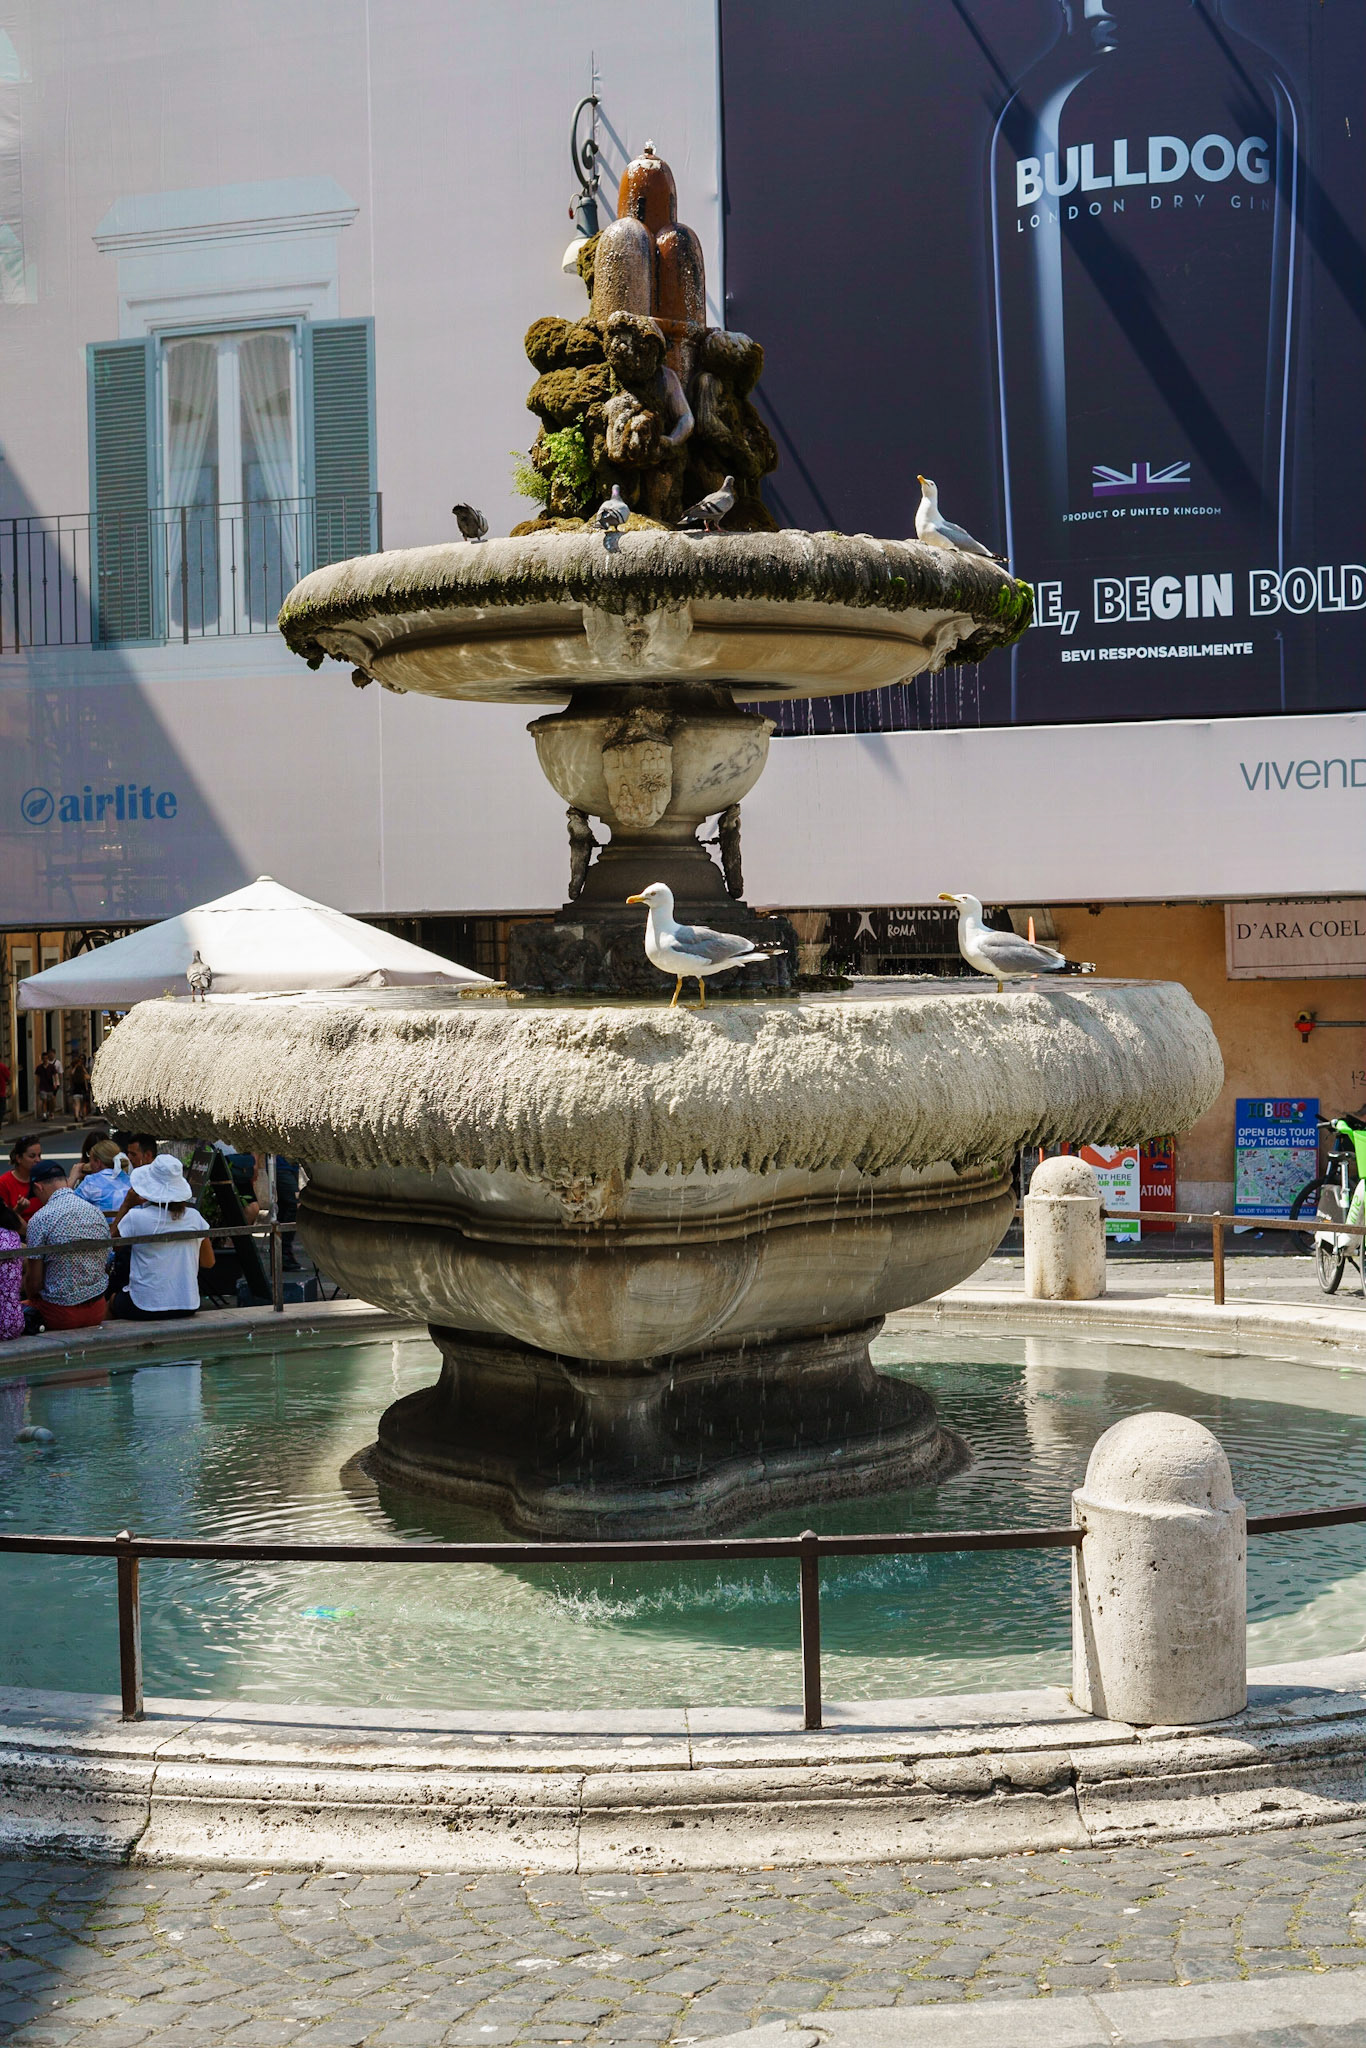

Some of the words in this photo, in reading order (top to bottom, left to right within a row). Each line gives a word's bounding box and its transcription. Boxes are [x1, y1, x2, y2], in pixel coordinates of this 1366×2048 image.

[1016, 133, 1270, 208] BULLDOG
[1017, 198, 1125, 233] LONDON
[1151, 194, 1206, 210] DRY
[1230, 194, 1271, 211] GIN
[1062, 509, 1108, 522] PRODUCT
[1112, 508, 1126, 518] OF
[1130, 507, 1170, 517] UNITED
[1173, 506, 1222, 516] KINGDOM
[1094, 573, 1233, 624] BEGIN
[1249, 565, 1366, 616] BOLD
[1061, 649, 1095, 663] BEVI
[1099, 642, 1253, 661] RESPONSABILMENTE
[59, 784, 177, 823] airlite
[1236, 922, 1304, 940] D'ARA
[1309, 920, 1366, 937] COEL
[1248, 1102, 1291, 1118] IOBUS
[1238, 1128, 1265, 1136] OPEN
[1267, 1128, 1287, 1136] BUS
[1289, 1128, 1316, 1136] TOUR
[1238, 1137, 1257, 1147] Buy
[1259, 1137, 1289, 1146] Ticket
[1292, 1137, 1316, 1146] Here
